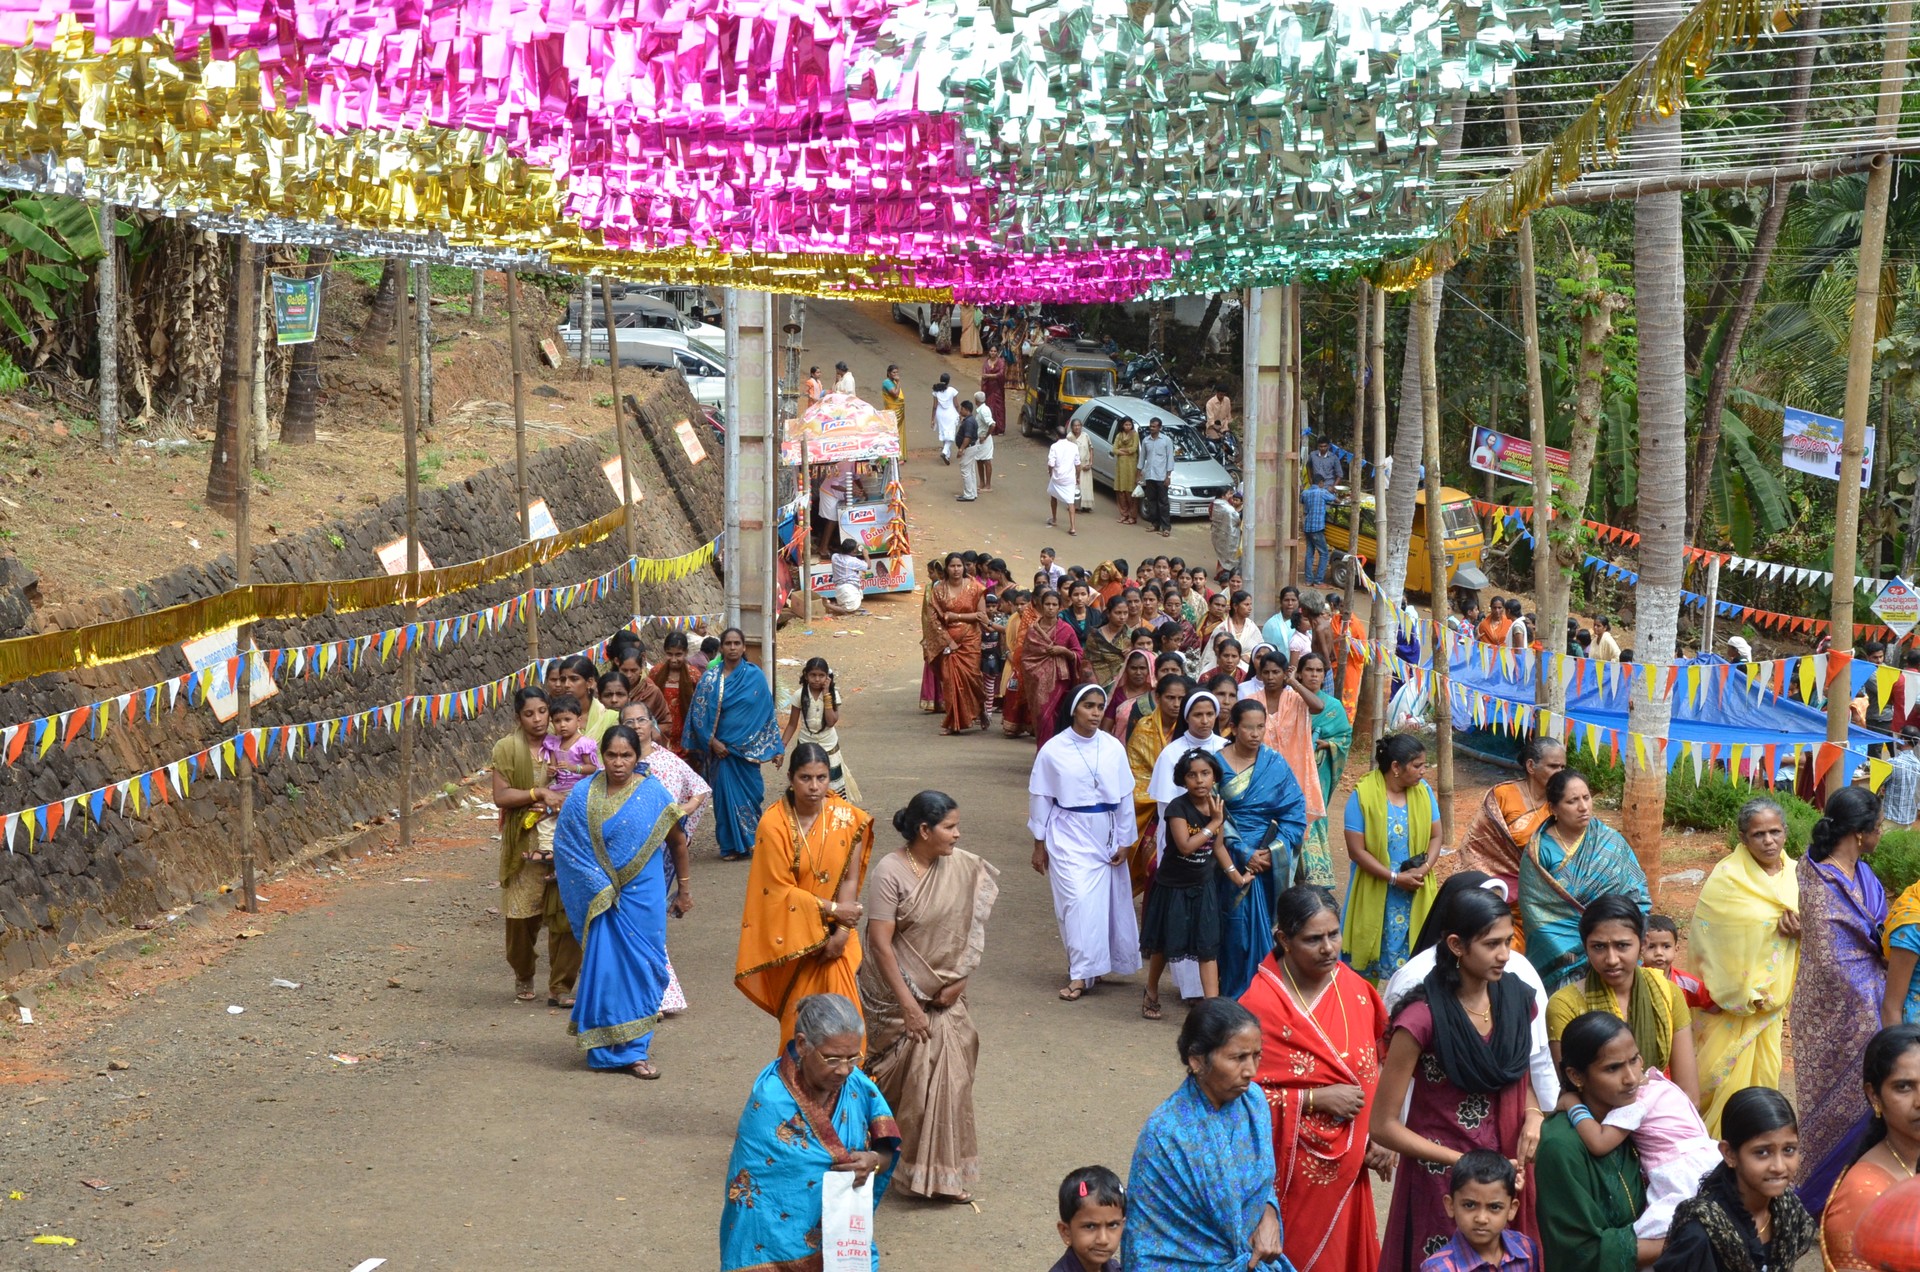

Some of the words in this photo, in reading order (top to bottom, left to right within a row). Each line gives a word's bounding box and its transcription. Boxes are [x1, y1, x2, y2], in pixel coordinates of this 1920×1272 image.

[823, 420, 855, 433] LAZZA
[825, 441, 856, 452] LAZZA
[850, 510, 873, 522] LAZZA
[811, 574, 834, 589] LAZZ
